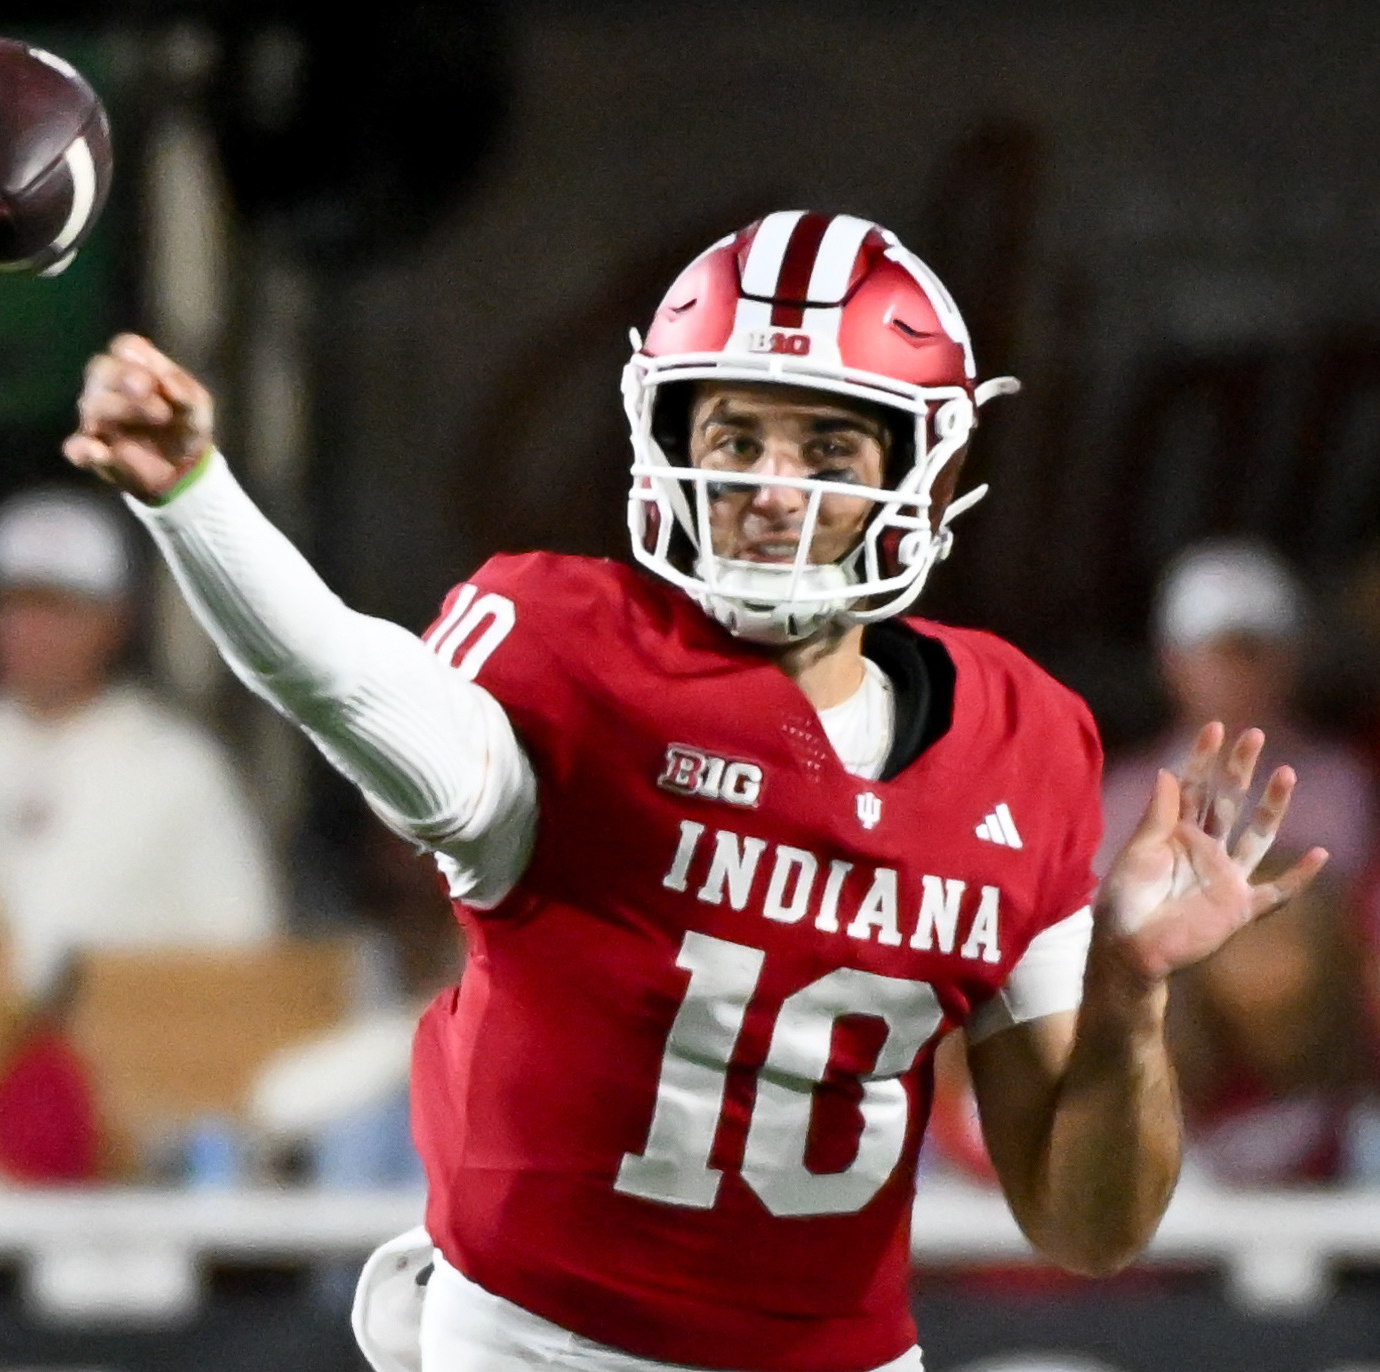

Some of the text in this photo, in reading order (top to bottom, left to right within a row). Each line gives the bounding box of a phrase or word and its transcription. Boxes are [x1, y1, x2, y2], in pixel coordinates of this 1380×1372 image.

[425, 583, 517, 682] 10
[663, 819, 1002, 962] INDIANA
[614, 930, 944, 1217] 10
